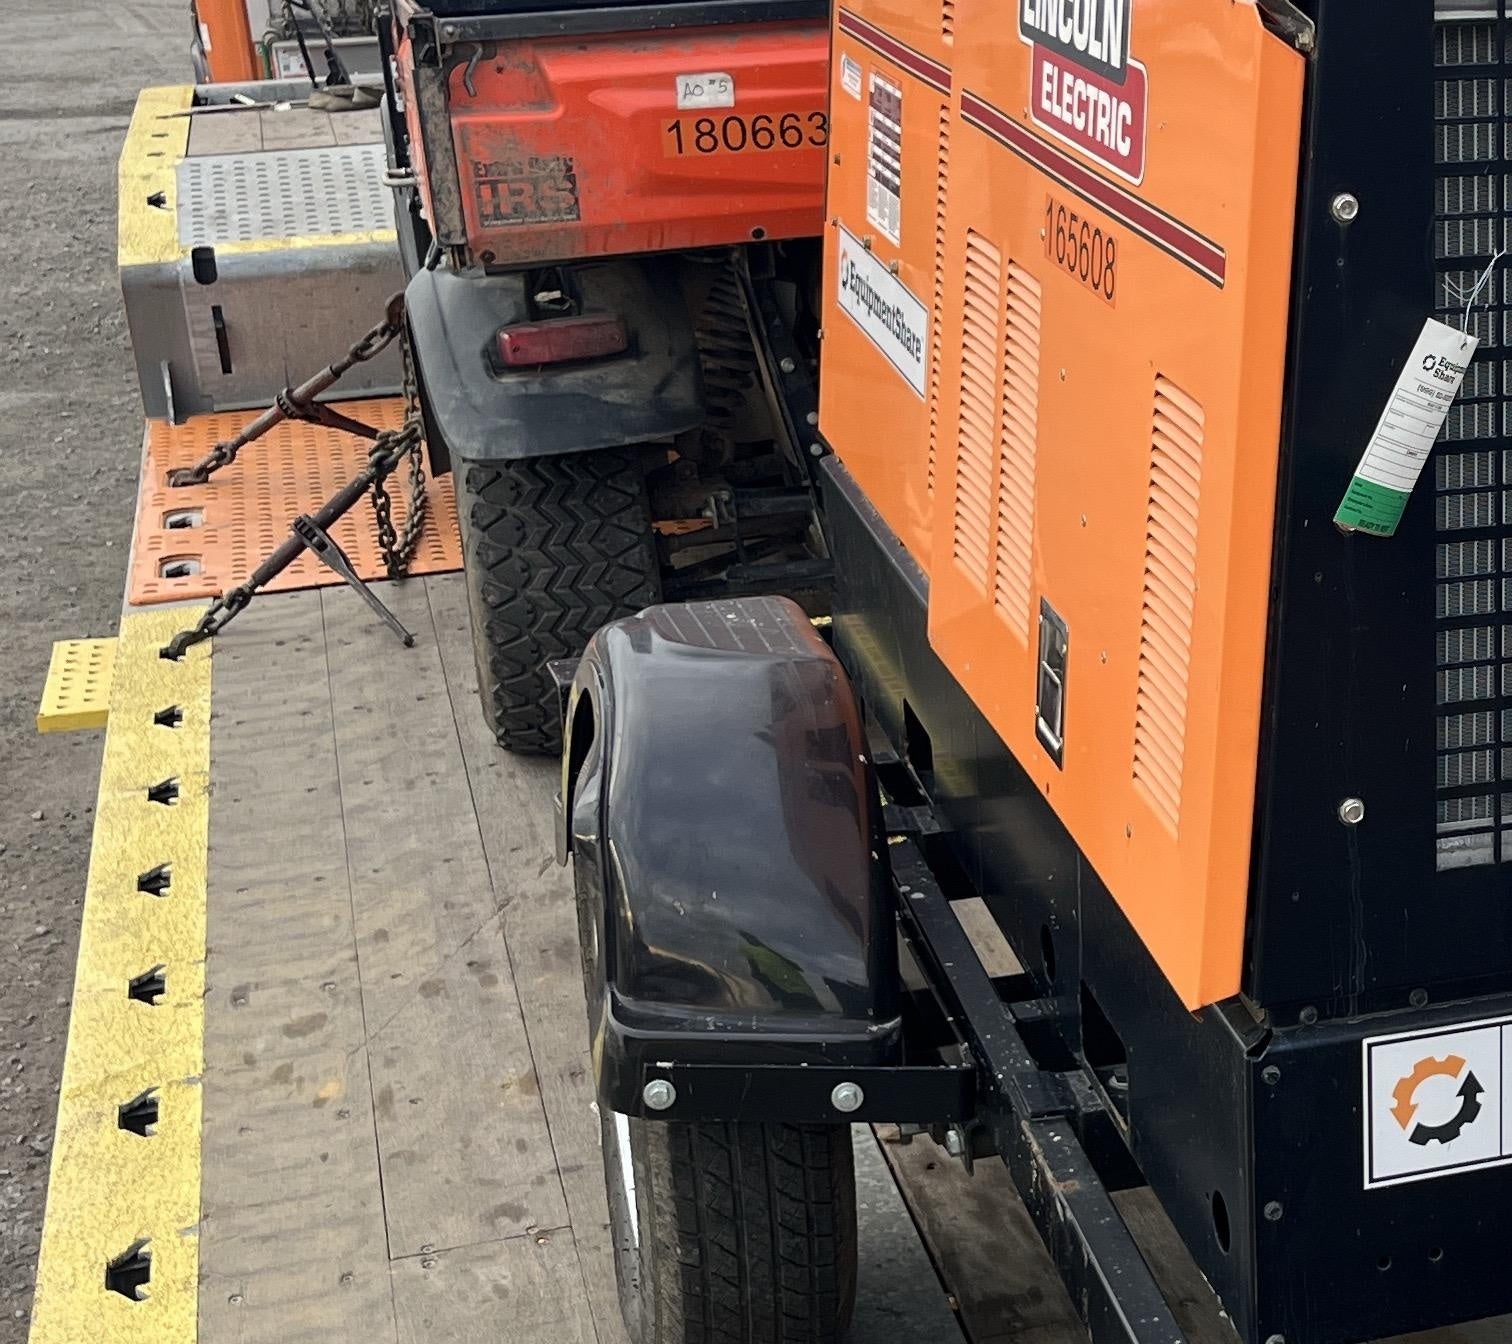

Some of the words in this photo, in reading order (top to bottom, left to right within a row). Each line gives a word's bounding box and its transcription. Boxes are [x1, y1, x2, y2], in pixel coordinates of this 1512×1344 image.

[667, 111, 829, 155] 180663
[1040, 60, 1133, 158] ELECTRIC
[1045, 198, 1116, 301] 165608
[849, 260, 922, 364] EquipmentShare
